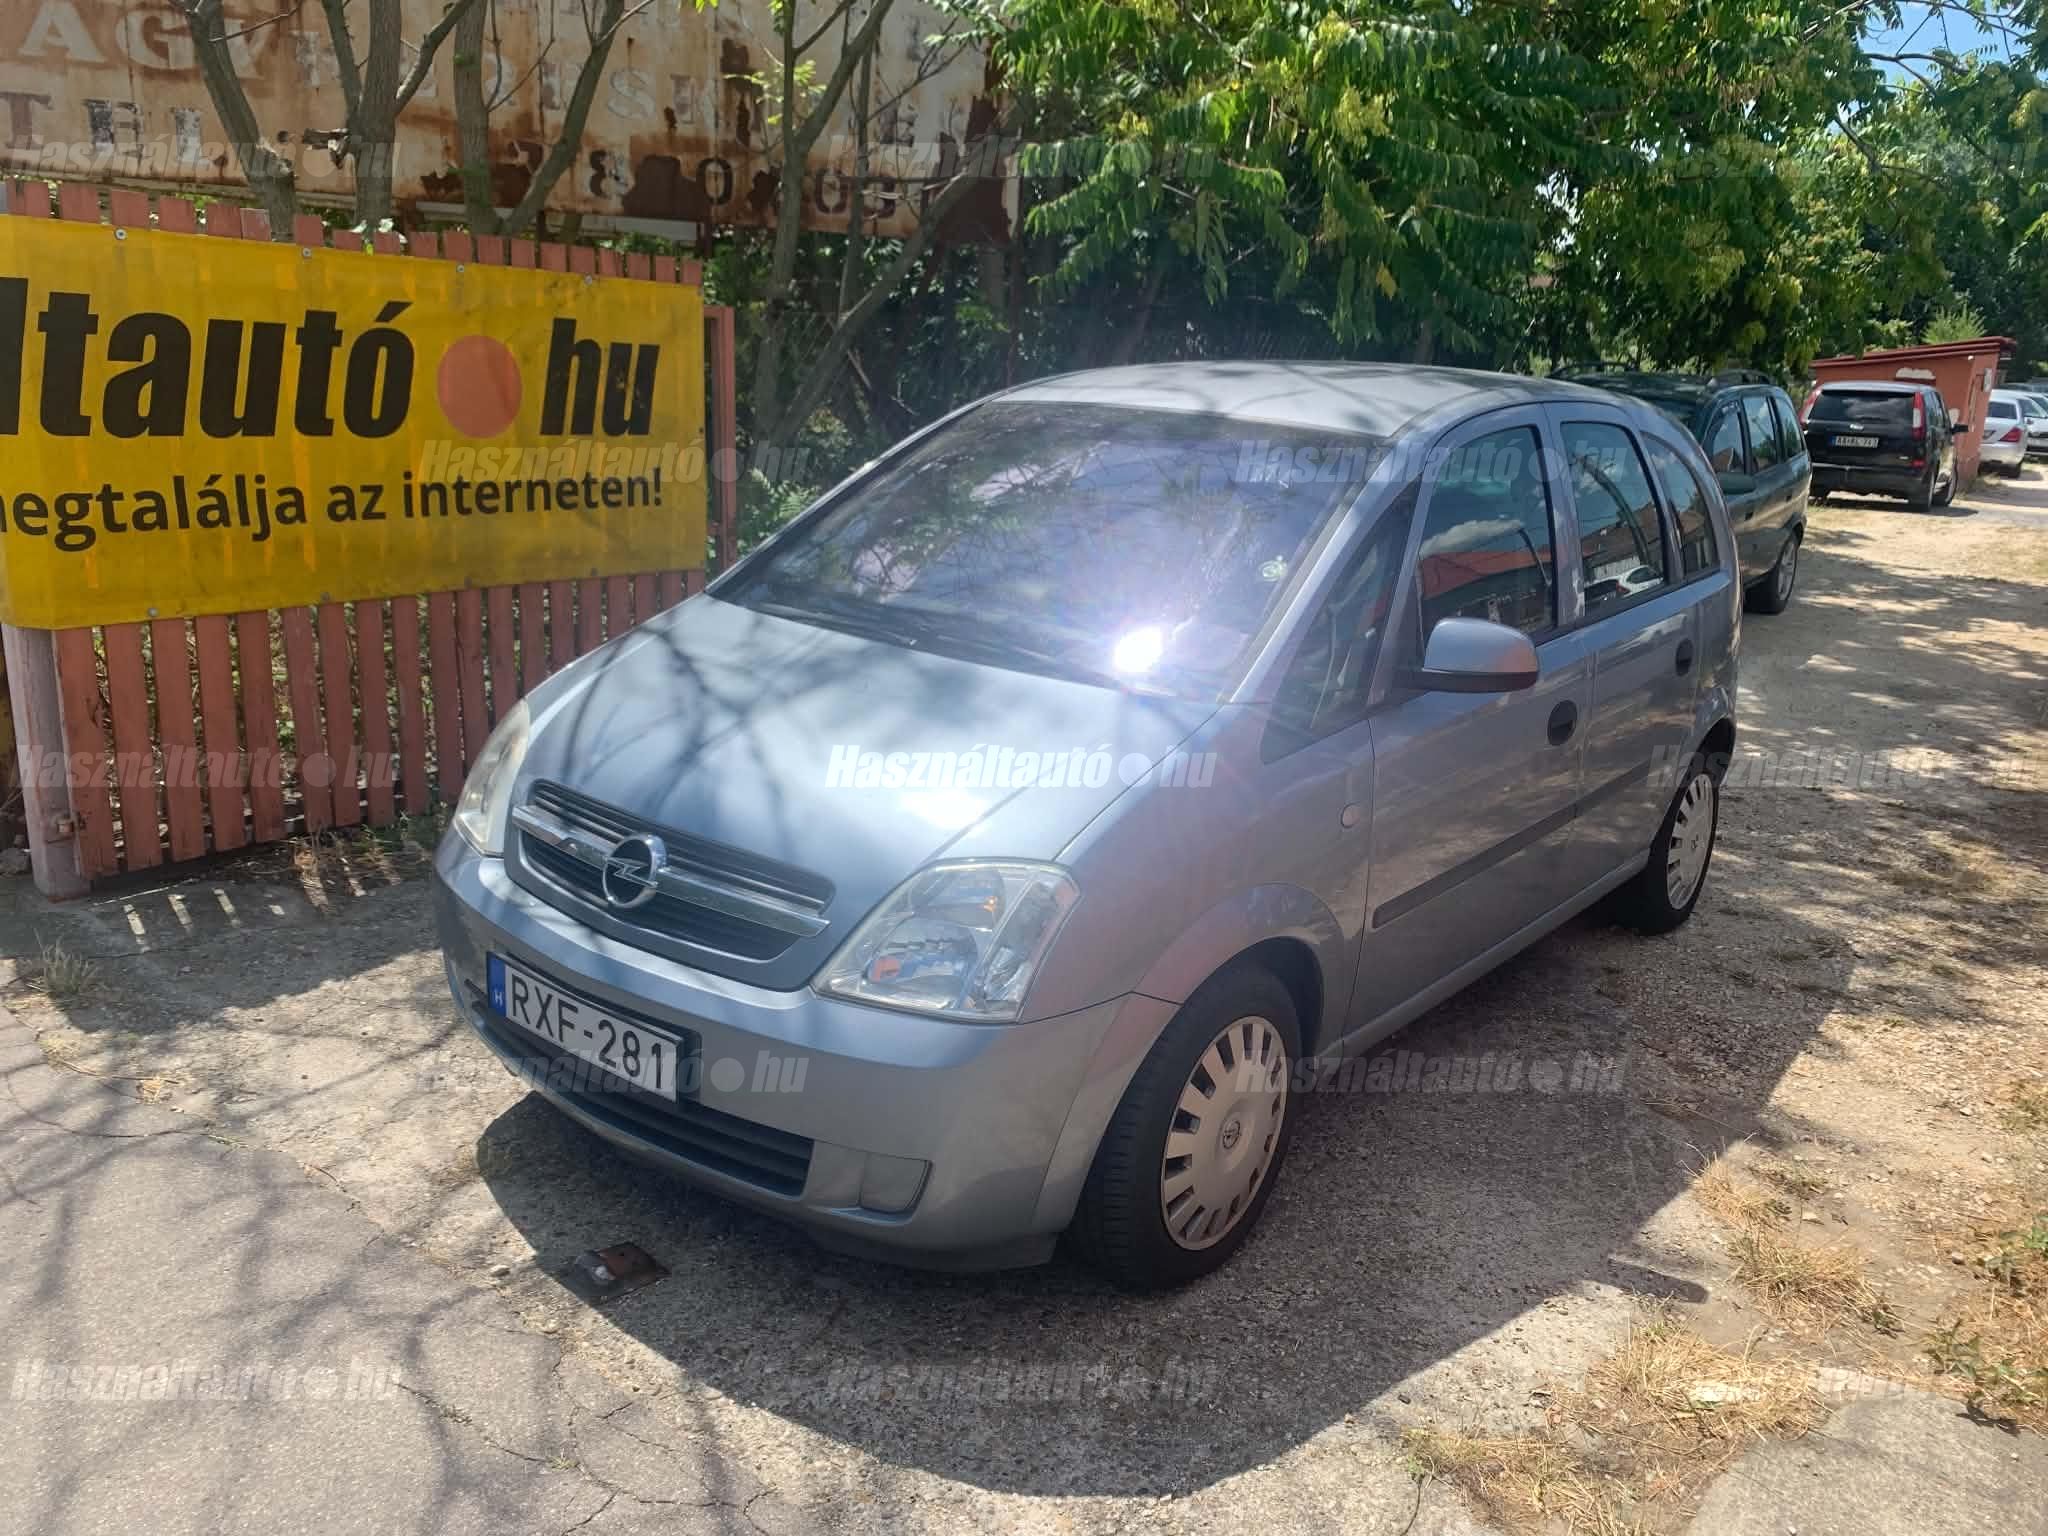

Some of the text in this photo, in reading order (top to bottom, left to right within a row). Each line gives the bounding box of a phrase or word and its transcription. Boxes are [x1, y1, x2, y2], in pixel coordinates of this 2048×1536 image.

[540, 318, 660, 436] hu
[0, 467, 662, 551] egtalálja az interneten!
[511, 973, 664, 1089] RXF-281
